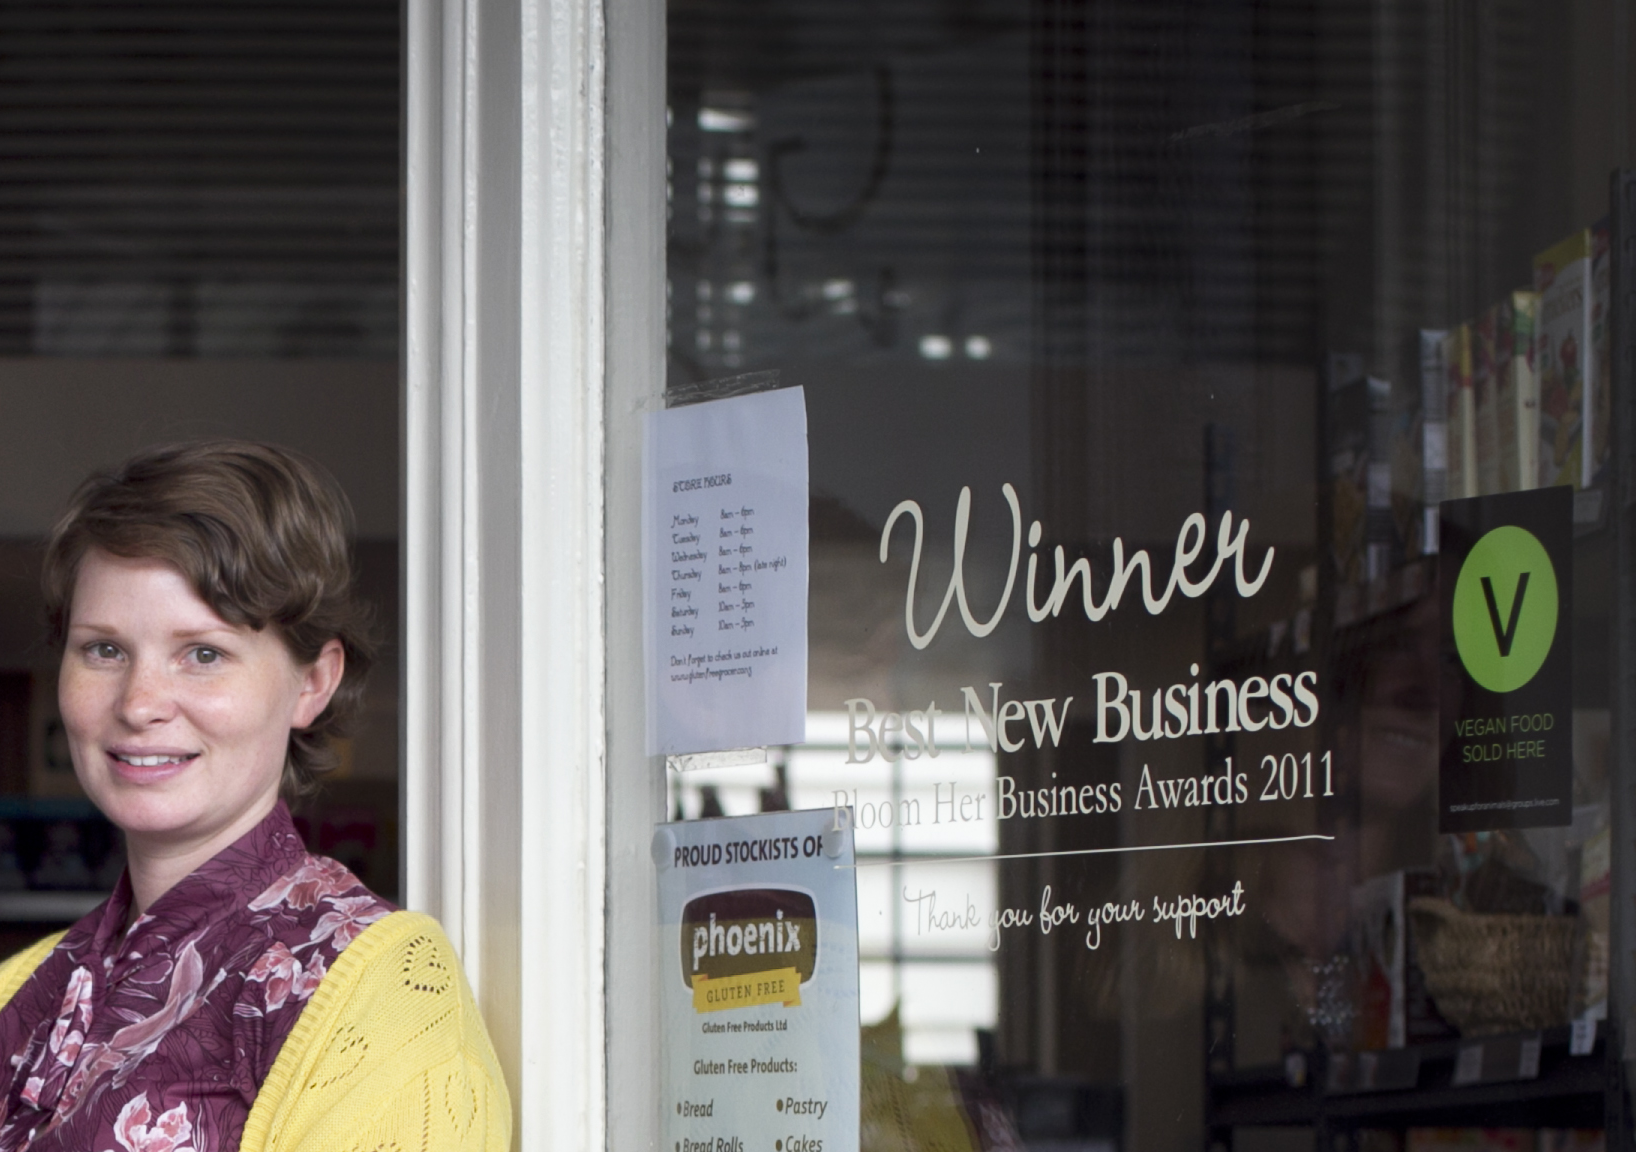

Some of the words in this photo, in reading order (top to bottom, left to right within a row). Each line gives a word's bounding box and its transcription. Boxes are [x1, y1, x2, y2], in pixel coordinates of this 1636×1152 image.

[879, 481, 1275, 650] Winner
[844, 696, 942, 765] Best
[960, 682, 1074, 754] New
[1092, 663, 1319, 744] Business
[1455, 716, 1507, 737] VEGAN
[1510, 713, 1554, 733] FOOD
[1462, 744, 1503, 763] SOLD
[1506, 740, 1546, 760] HERE
[831, 788, 922, 832] Bloom
[933, 780, 986, 825] Her
[996, 771, 1122, 820] Business
[1134, 756, 1249, 810] Awards
[1259, 750, 1334, 801] 2011
[674, 844, 723, 868] PROUD
[725, 836, 798, 865] STOCKISTS
[902, 885, 982, 936] Thank
[988, 907, 1033, 952] you
[1039, 885, 1079, 934] for
[1086, 899, 1145, 950] your
[1153, 880, 1246, 940] support
[692, 908, 801, 971] phoenix
[706, 984, 752, 1004] GLUTEN
[757, 979, 786, 997] FREE
[702, 1022, 725, 1034] Gluten
[727, 1021, 742, 1033] Free
[743, 1020, 774, 1033] Products
[775, 1019, 788, 1032] Ltd
[694, 1060, 725, 1076] Gluten
[728, 1058, 749, 1074] Free
[751, 1056, 798, 1075] Products:
[683, 1098, 714, 1117] Bread
[785, 1097, 828, 1120] Pastry
